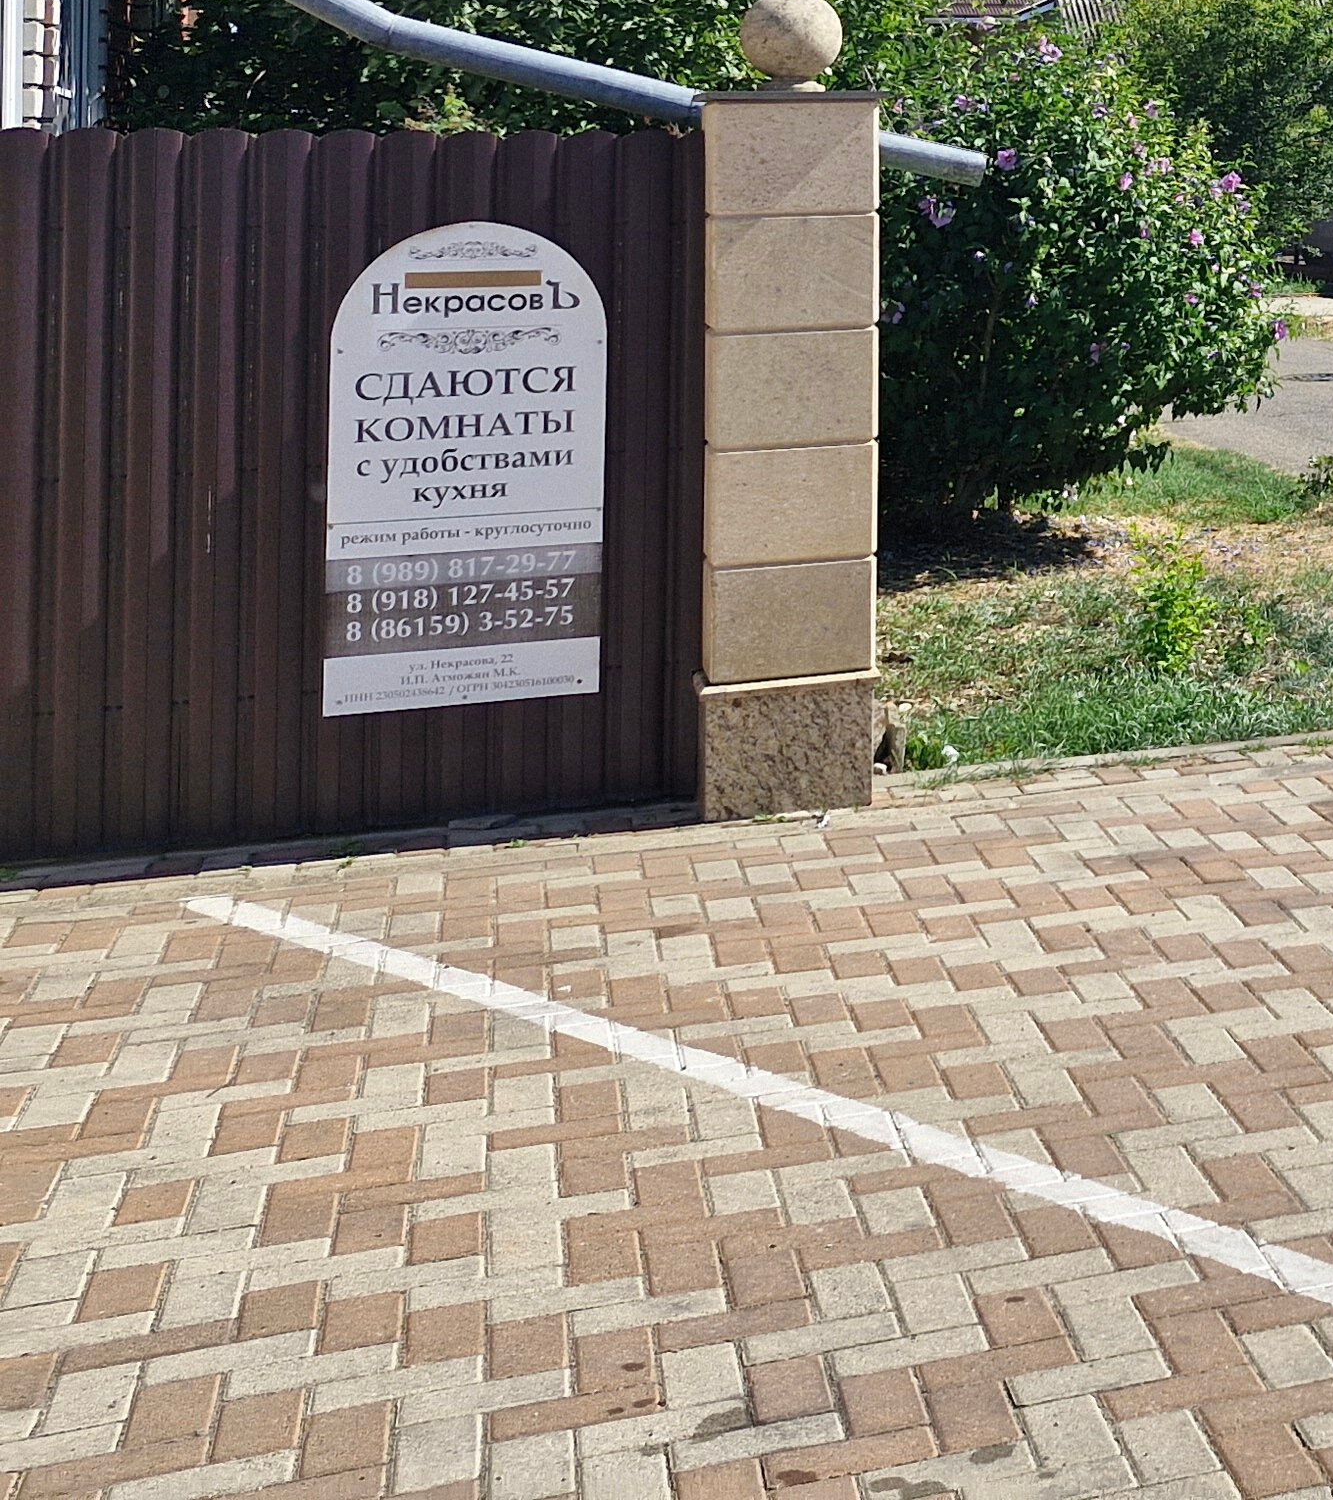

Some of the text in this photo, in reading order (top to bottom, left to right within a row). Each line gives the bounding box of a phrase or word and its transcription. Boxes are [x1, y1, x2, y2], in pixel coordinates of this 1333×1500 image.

[371, 280, 580, 318] НекрасовЪ
[355, 366, 577, 406] СДАЮТСЯ
[354, 409, 575, 443] КОМНАТЫ
[356, 449, 574, 483] с удобствами
[413, 482, 508, 509] кухня
[341, 527, 397, 548] режим
[401, 522, 460, 545] работы
[475, 518, 592, 540] круглосуточно
[347, 550, 577, 585] 8 (989) 817-29-77
[346, 578, 576, 614] 8 (918) 127-45-57
[346, 605, 574, 642] 8 (86159) 3-52-75
[409, 653, 514, 673] ул. Некрасова, 22
[493, 666, 521, 678] М.К.
[456, 683, 489, 693] ОГРН
